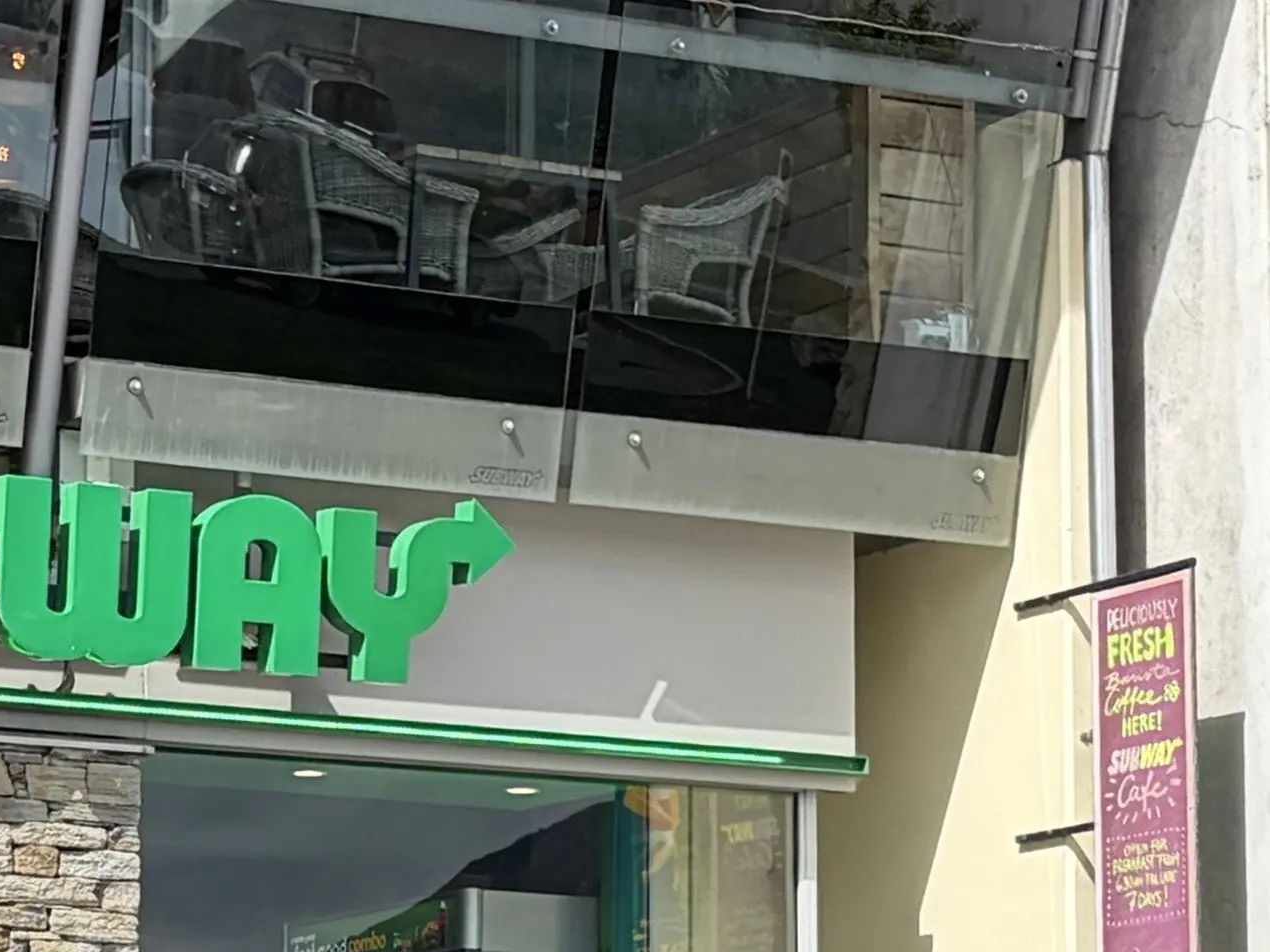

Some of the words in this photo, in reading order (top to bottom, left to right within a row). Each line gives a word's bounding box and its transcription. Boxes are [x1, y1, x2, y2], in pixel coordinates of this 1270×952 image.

[467, 465, 543, 488] SUBWAY
[1106, 598, 1178, 632] DELICIOUSLY
[1106, 621, 1175, 669] FRESH
[1104, 663, 1180, 691] Barista
[1104, 686, 1163, 716] Coffee
[1122, 709, 1162, 738] HERE!
[1107, 736, 1183, 775] SUBWAY
